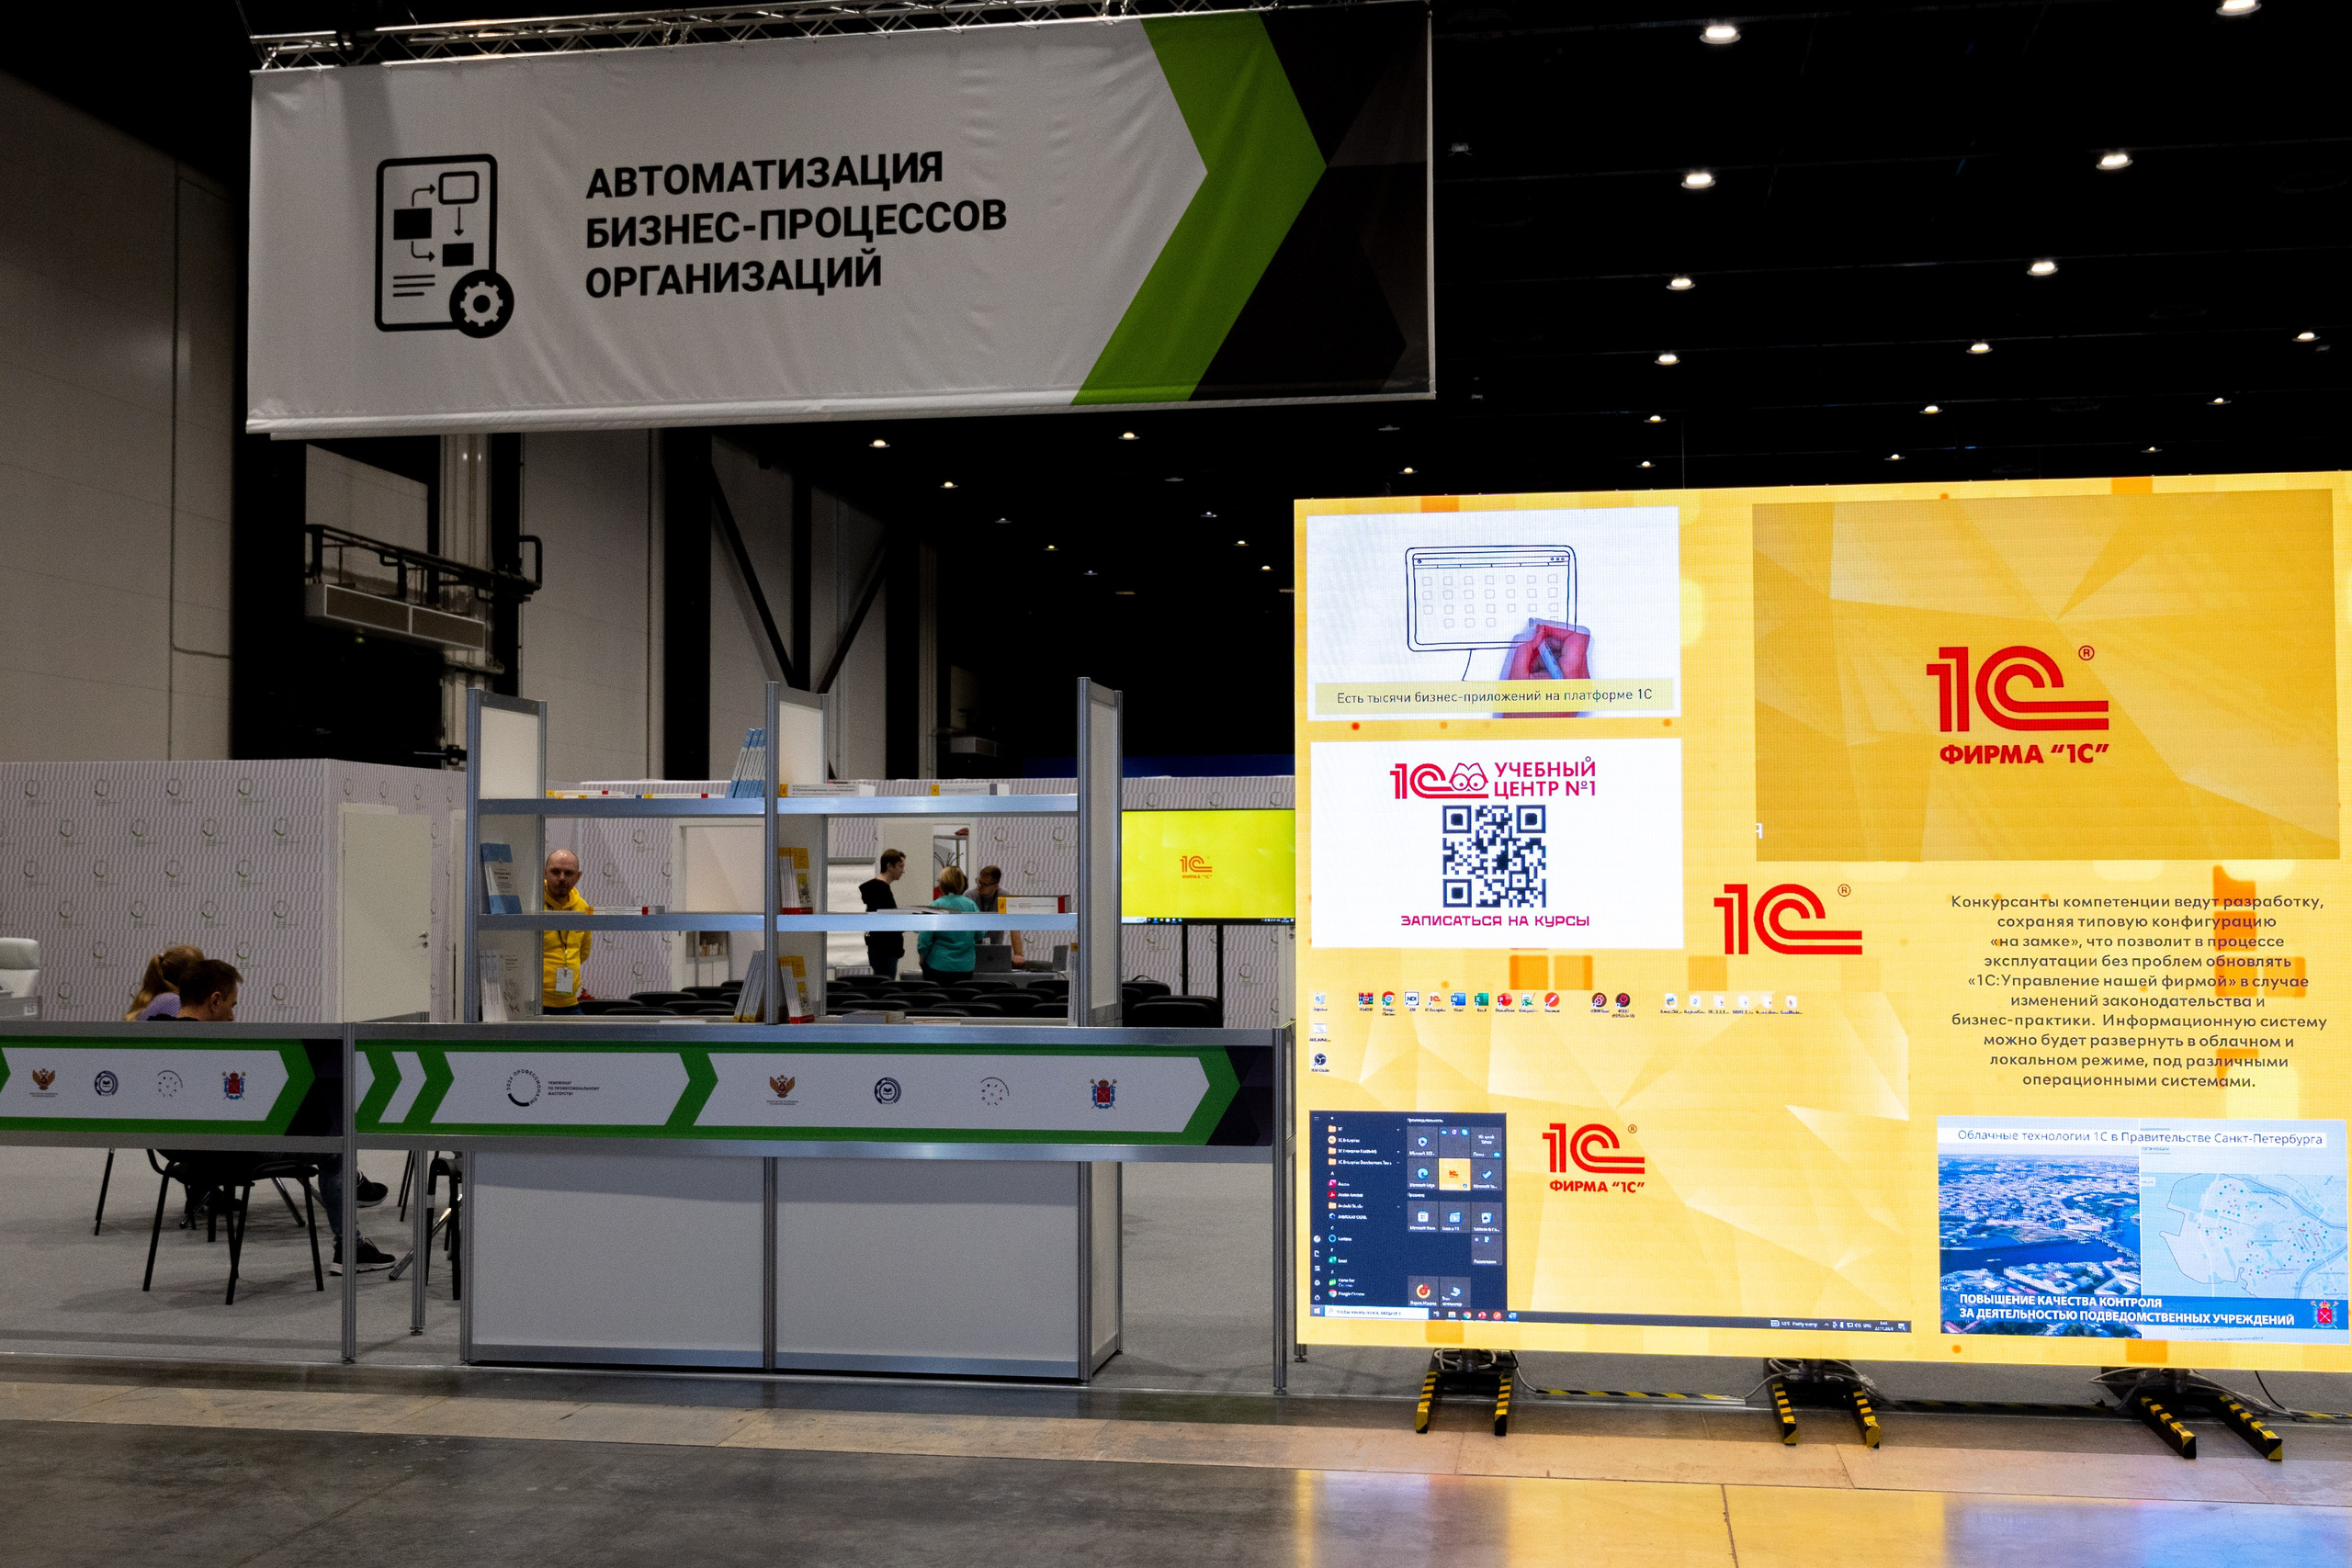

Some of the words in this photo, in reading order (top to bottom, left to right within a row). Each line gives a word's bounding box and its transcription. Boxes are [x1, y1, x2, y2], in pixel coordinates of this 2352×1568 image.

[586, 151, 944, 198] АВТОМАТИЗАЦИЯ
[586, 198, 1007, 249] БИЗНЕС-ПРОЦЕССОВ
[585, 248, 882, 299] ОРГАНИЗАЦИЙ
[1337, 692, 1364, 705] Есть
[1367, 693, 1411, 705] тысячи
[1415, 689, 1542, 704] бизнес-приложений
[1545, 693, 1561, 701] на
[1565, 690, 1633, 704] платформе
[1637, 688, 1652, 699] 1С
[1939, 744, 2043, 765] ФИРМА
[1495, 756, 1596, 778] УЧЕБНЫЙ
[1495, 781, 1558, 799] ЦЕНТР
[1952, 897, 2058, 910] Конкурсанты
[2064, 899, 2169, 908] компетенции
[2176, 899, 2219, 909] ведут
[2224, 896, 2323, 910] разработку,
[1401, 916, 1502, 927] ЗАПИСАТЬСЯ
[1509, 916, 1529, 926] НА
[1534, 914, 1589, 927] КУРСЫ
[1997, 919, 2073, 930] сохраняя
[2078, 919, 2147, 930] типовую
[2153, 916, 2276, 930] конфигурацию
[2023, 939, 2082, 948] замке»,
[2208, 939, 2284, 950] процессе
[1984, 958, 2097, 969] эксплуатации
[2102, 954, 2128, 966] без
[2132, 955, 2201, 969] проблем
[2207, 955, 2290, 966] обновлять
[2104, 976, 2156, 986] нашей
[2162, 976, 2235, 989] фирмой»
[2241, 978, 2248, 987] в
[2253, 978, 2308, 990] случае
[2012, 995, 2098, 1006] изменений
[2103, 998, 2251, 1009] законодательства
[2256, 998, 2264, 1007] и
[1952, 1013, 2095, 1028] бизнес-практики.
[2104, 1014, 2256, 1030] Информационную
[2261, 1019, 2326, 1030] систему
[1984, 1037, 2037, 1045] можно
[2041, 1033, 2086, 1048] будет
[2091, 1037, 2183, 1049] развернуть
[2188, 1038, 2195, 1046] в
[2199, 1035, 2280, 1046] облачном
[2286, 1039, 2293, 1047] и
[1990, 1056, 2076, 1065] локальном
[2082, 1057, 2147, 1068] режиме,
[2154, 1058, 2182, 1067] под
[2187, 1058, 2288, 1069] различными
[513, 1069, 541, 1105] ПРОФЕССИОНАЛЫ
[2023, 1077, 2156, 1088] операционными
[2162, 1077, 2255, 1087] системами.
[1958, 1130, 2018, 1140] Облачные
[2022, 1131, 2091, 1143] технологии
[2094, 1131, 2108, 1142] 1С
[2111, 1134, 2118, 1142] в
[2121, 1132, 2211, 1145] Правительстве
[2214, 1134, 2323, 1146] Санкт-Петербурга
[1550, 1179, 1608, 1192] ФИРМА
[1960, 1294, 2035, 1307] ПОВЫШЕНИЕ
[2037, 1295, 2097, 1307] КАЧЕСТВА
[2099, 1297, 2162, 1308] КОНТРОЛЯ
[1960, 1308, 1974, 1318] ЗА
[1976, 1308, 2076, 1321] ДЕЯТЕЛЬНОСТЬЮ
[2080, 1311, 2211, 1325] ПОДВЕДОМСТВЕННЫХ
[2213, 1311, 2294, 1327] УЧРЕЖДЕНИЙ
